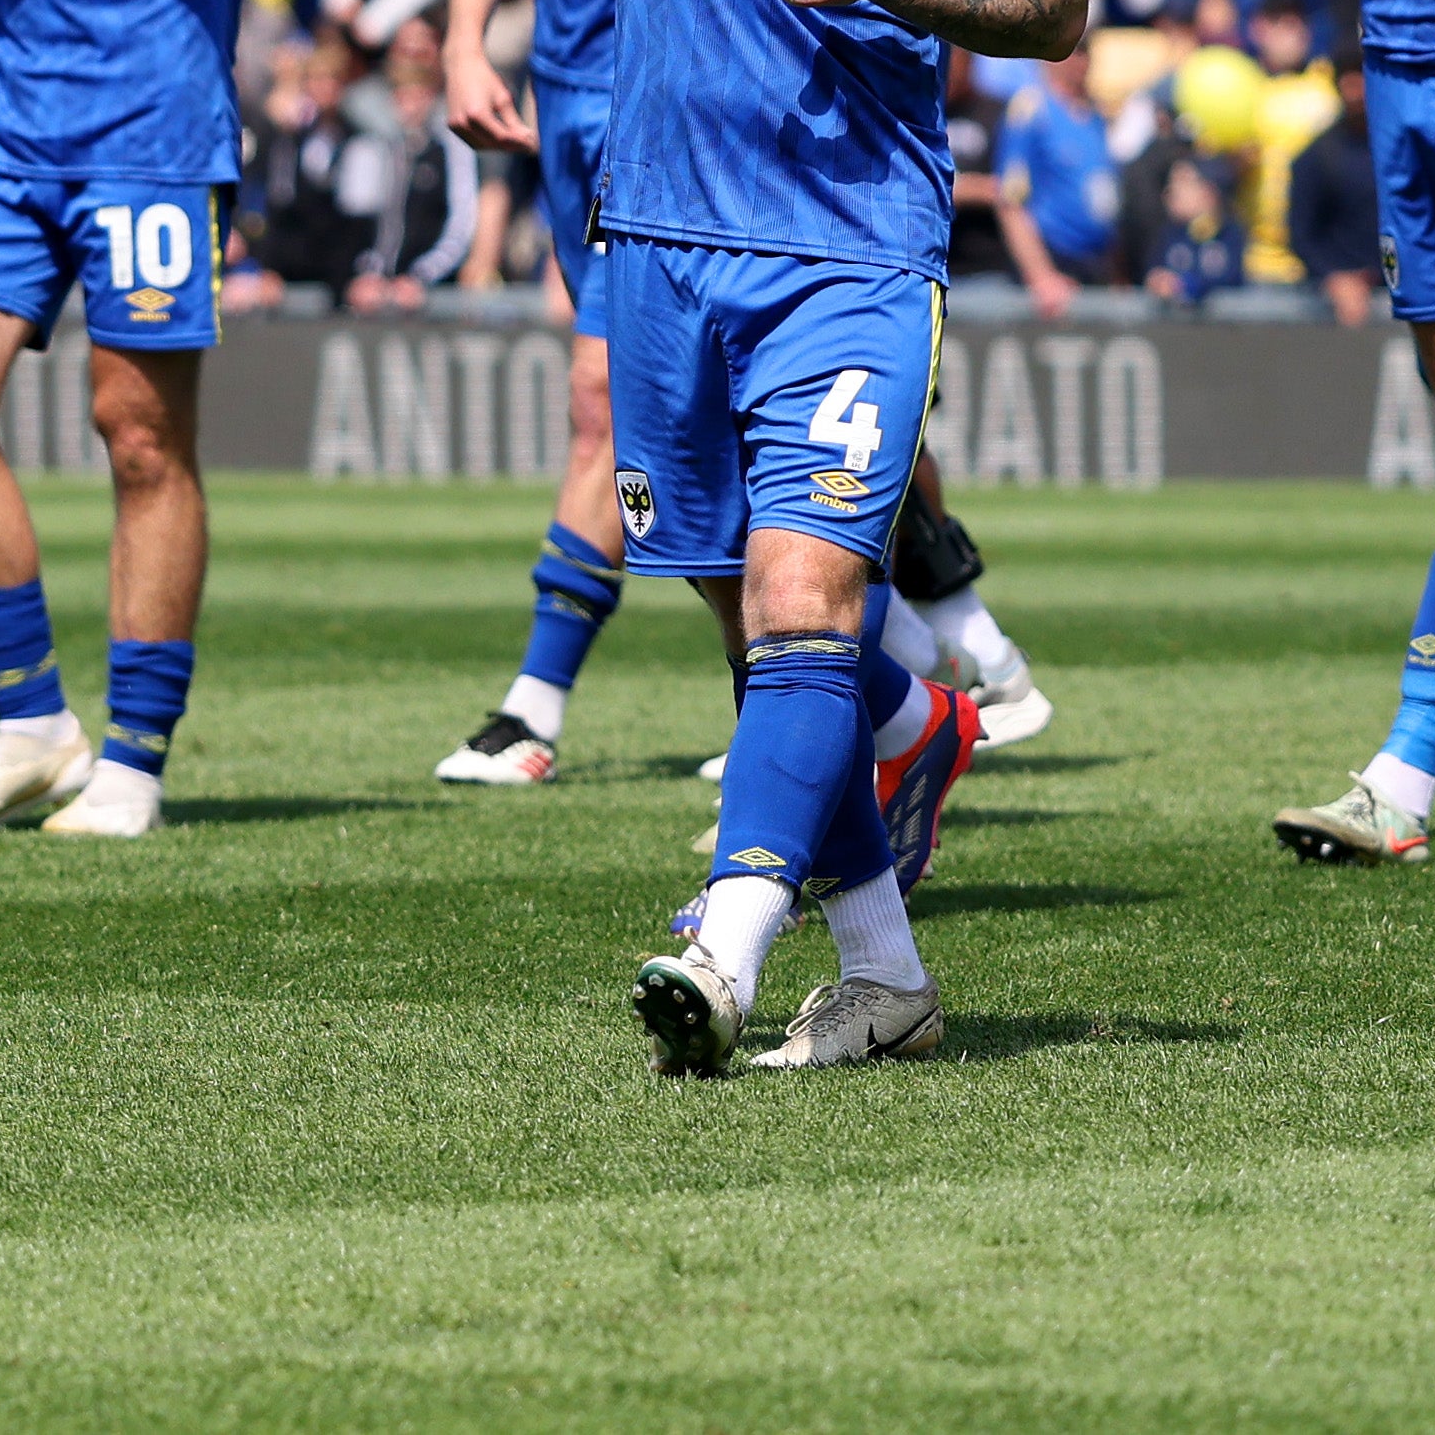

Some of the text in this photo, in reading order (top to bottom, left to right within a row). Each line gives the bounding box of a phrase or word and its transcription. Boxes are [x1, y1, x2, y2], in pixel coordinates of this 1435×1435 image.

[95, 201, 193, 290] 10
[309, 330, 570, 479] ANTO
[808, 369, 882, 472] 4
[809, 491, 858, 514] umbro
